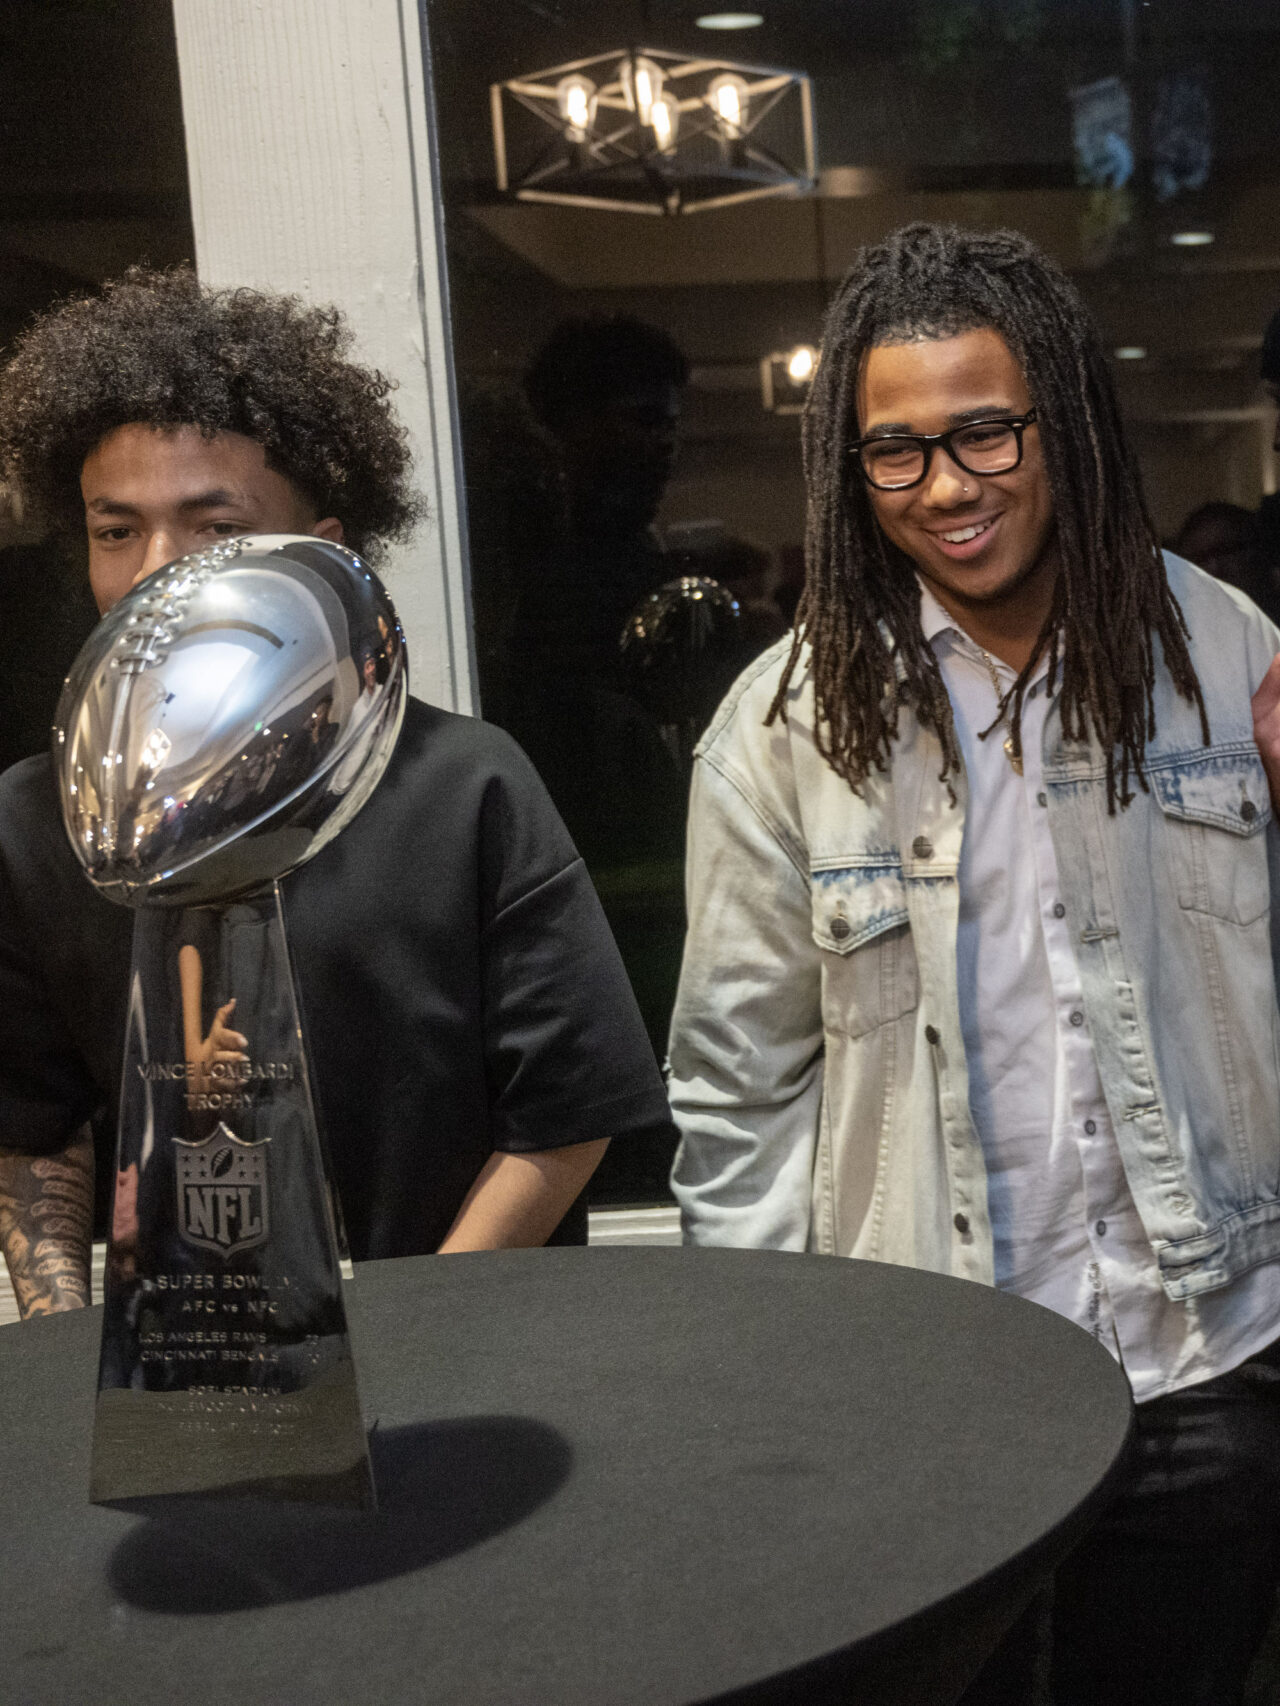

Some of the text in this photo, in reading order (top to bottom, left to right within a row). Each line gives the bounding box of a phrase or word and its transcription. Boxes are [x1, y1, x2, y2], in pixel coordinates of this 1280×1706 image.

[137, 1062, 295, 1079] VINCE LOMBARDI
[183, 1093, 253, 1110] TROPHY
[187, 1187, 261, 1244] NFL
[157, 1274, 214, 1290] SUPER
[223, 1274, 270, 1290] BOWL
[182, 1300, 216, 1313] AFC
[248, 1300, 280, 1313] NFC
[138, 1331, 164, 1343] LOS
[167, 1331, 228, 1343] ANGELES
[232, 1331, 267, 1343] RAMS
[141, 1350, 217, 1361] CINCINNATI
[221, 1350, 279, 1362] BENGALS
[224, 1385, 281, 1397] STADIUM
